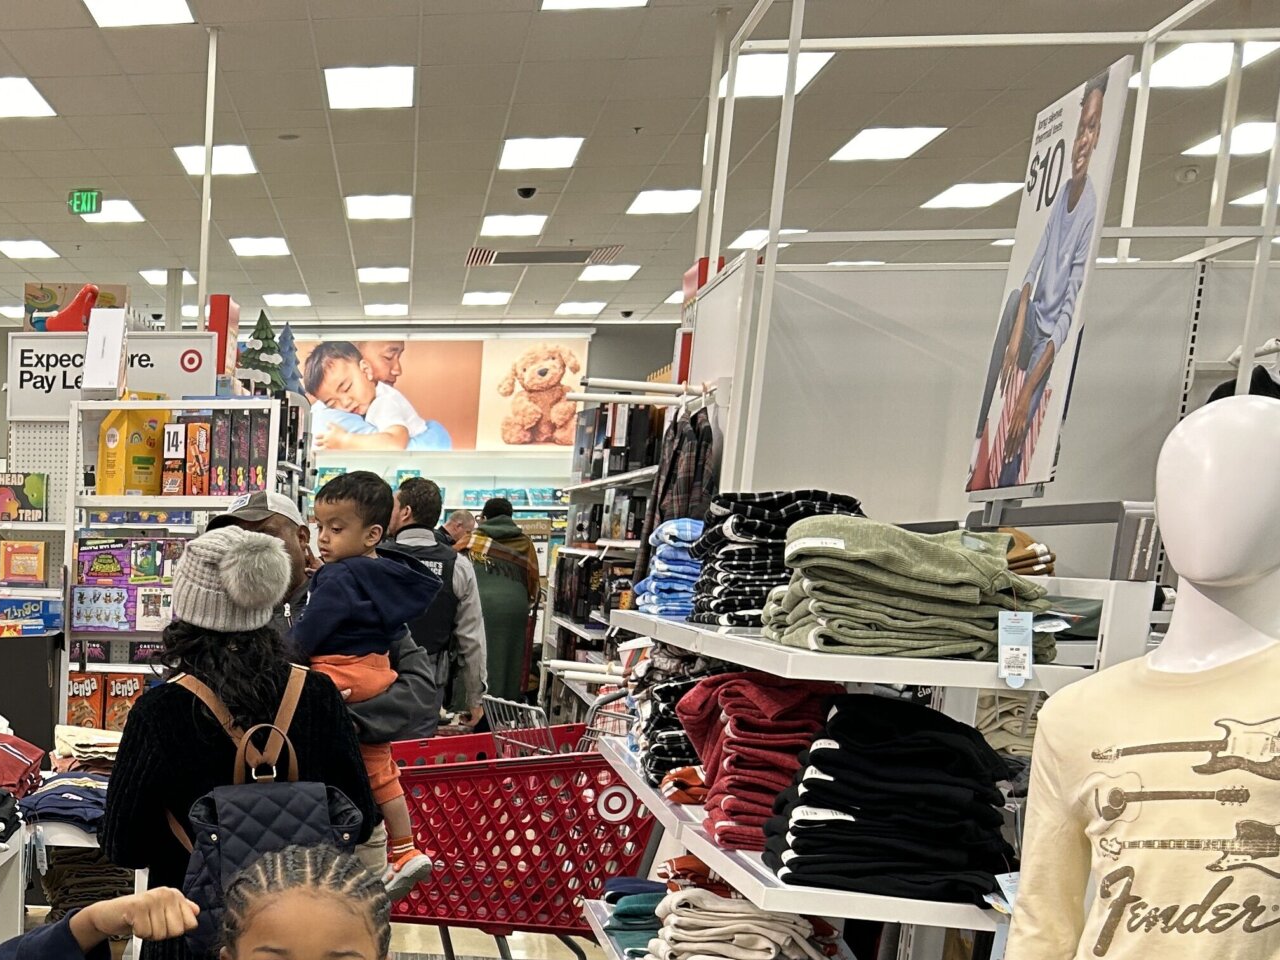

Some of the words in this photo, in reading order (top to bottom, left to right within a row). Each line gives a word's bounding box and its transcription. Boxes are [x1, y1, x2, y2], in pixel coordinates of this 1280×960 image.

[1027, 139, 1065, 212] $10
[73, 192, 98, 212] EXIT
[20, 349, 84, 372] Expec
[127, 353, 154, 368] re.
[20, 371, 56, 393] Pay
[18, 509, 43, 521] TRIP
[524, 521, 547, 530] venflo
[68, 677, 97, 697] Jenga
[110, 677, 140, 697] Jenga
[1093, 865, 1280, 957] Fender
